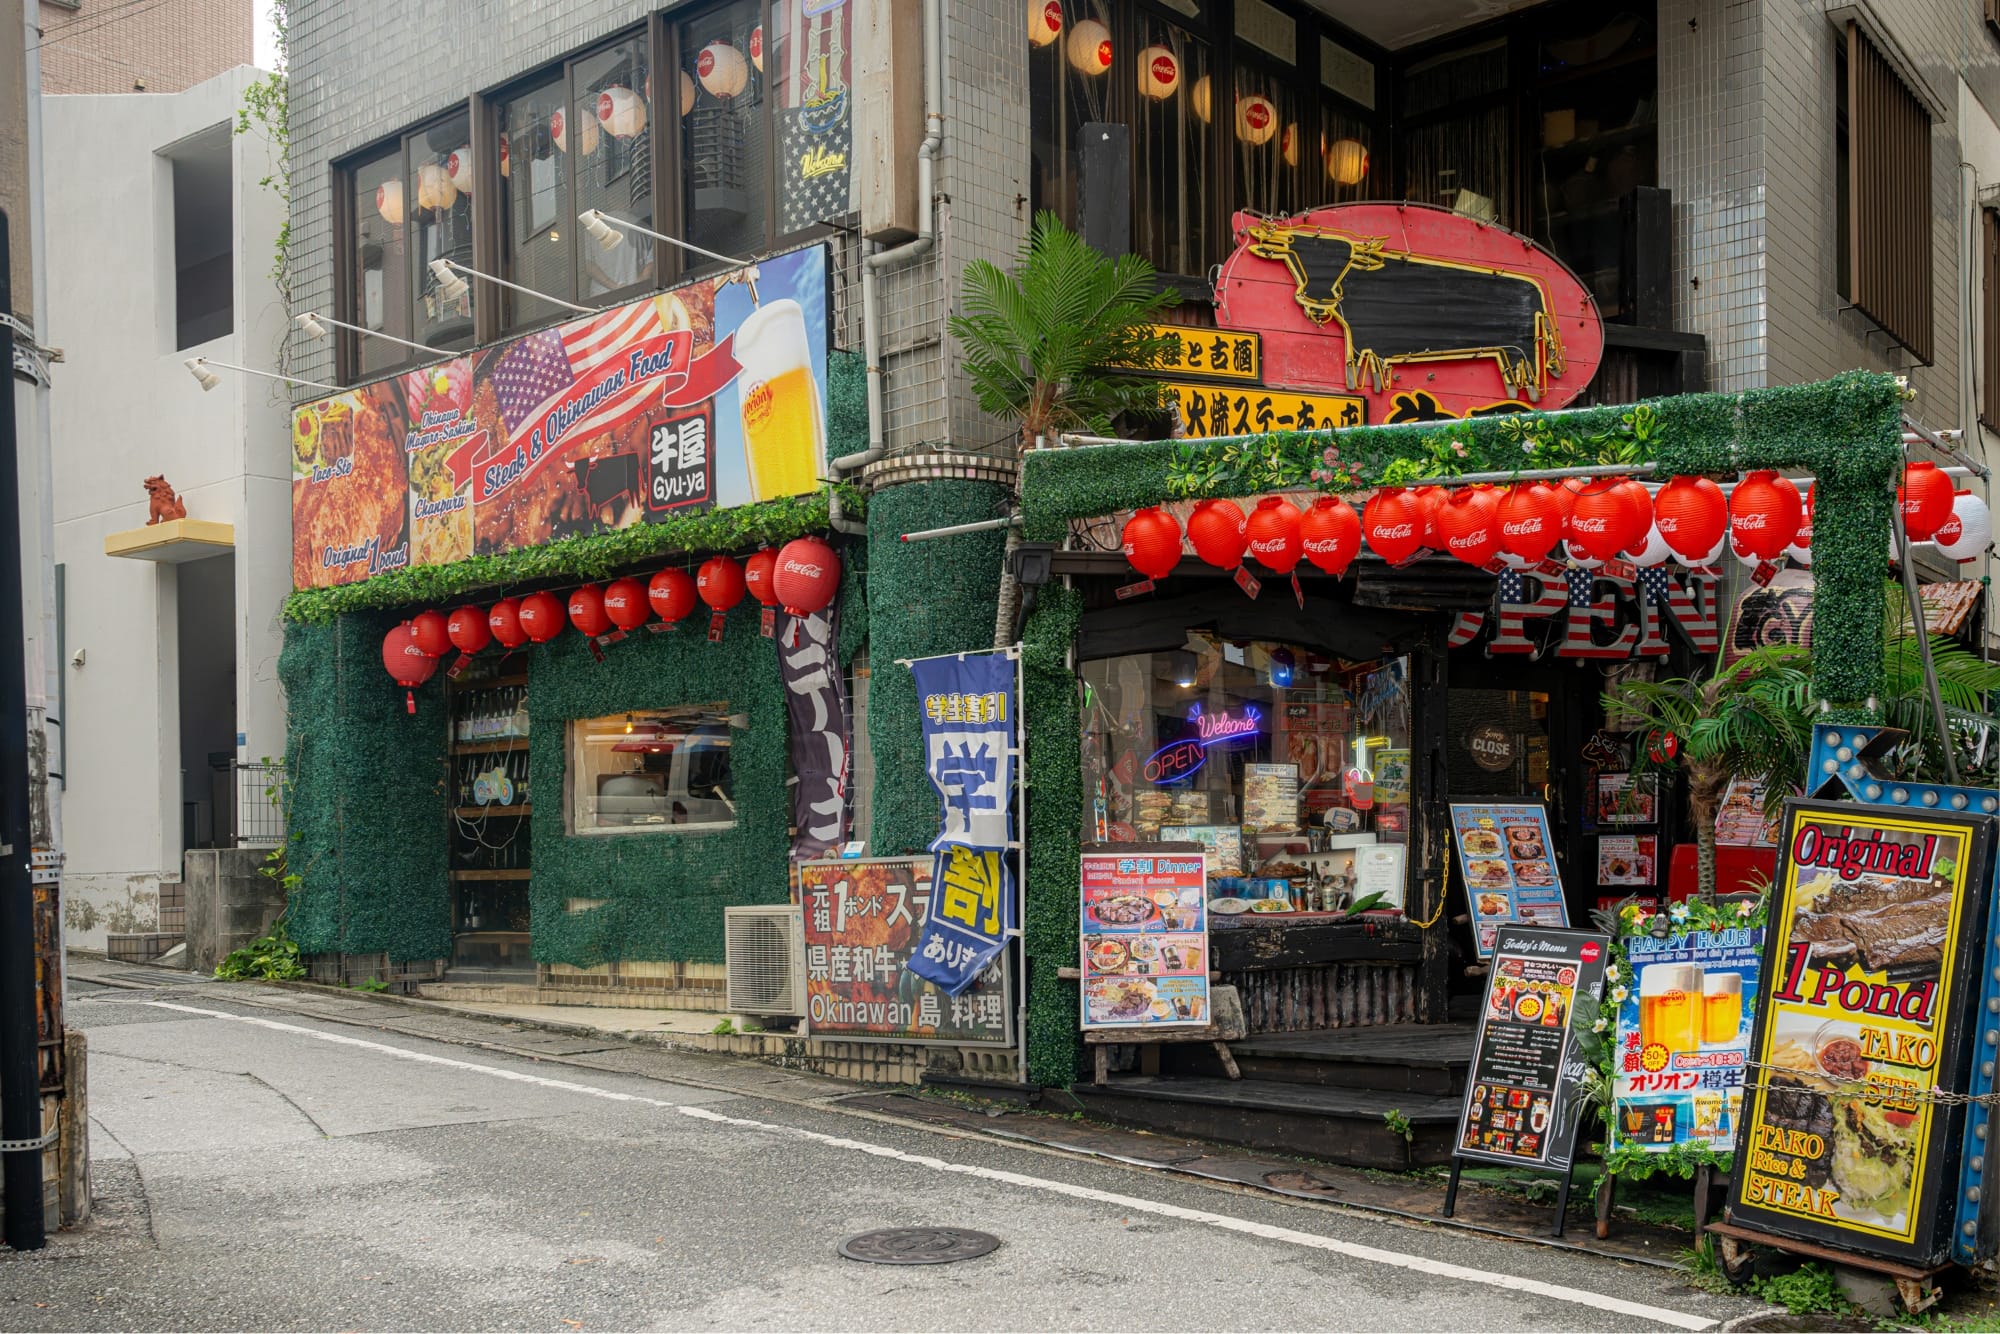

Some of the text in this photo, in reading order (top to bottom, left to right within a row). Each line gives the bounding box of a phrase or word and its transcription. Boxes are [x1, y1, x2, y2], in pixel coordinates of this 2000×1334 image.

[800, 145, 845, 178] Welcome
[421, 408, 460, 429] Okinawa
[483, 341, 674, 496] Steak & Okinawan Food
[1169, 388, 1359, 437] 火焼ステーキの店
[405, 418, 478, 451] Maguro-Sashimi
[651, 418, 707, 474] 牛屋
[311, 457, 353, 484] Taco-Ste
[652, 471, 707, 502] Gyu-ya
[414, 496, 467, 520] Chanpuru
[1373, 523, 1414, 539] Coca-Cola
[1449, 528, 1488, 548] Coca-Cola
[1503, 517, 1543, 536] Coca-Cola
[1571, 515, 1608, 533] Coca-Cola
[323, 536, 408, 574] Original 1 pond
[1251, 538, 1286, 553] Coca-Cola
[1303, 538, 1339, 553] Coca-Cola
[784, 559, 824, 579] Coca-Cola
[925, 692, 1007, 725] 学生割引
[1198, 713, 1255, 739] Welcome
[1485, 728, 1505, 742] Sorry
[1472, 738, 1510, 756] CLOSE
[1143, 744, 1206, 783] OPEN
[1119, 859, 1154, 875] 学割
[1157, 859, 1201, 874] Dinner
[1793, 824, 1939, 882] Original
[811, 884, 832, 933] 元祖
[1503, 938, 1568, 953] Today's Menu
[1630, 928, 1751, 955] HAPPY HOUR
[807, 944, 898, 983] 県産和牛
[1773, 942, 1811, 1004] 1
[810, 994, 912, 1026] Okinawan
[1623, 1031, 1642, 1073] 半額
[1646, 1050, 1665, 1061] 50%
[1859, 1028, 1937, 1069] TAKO
[1629, 1069, 1744, 1092] オリオン 樽生
[1864, 1073, 1920, 1112] STE
[1757, 1125, 1825, 1159] TAKO
[1753, 1151, 1807, 1178] Rice &
[1749, 1176, 1840, 1219] STEAK
